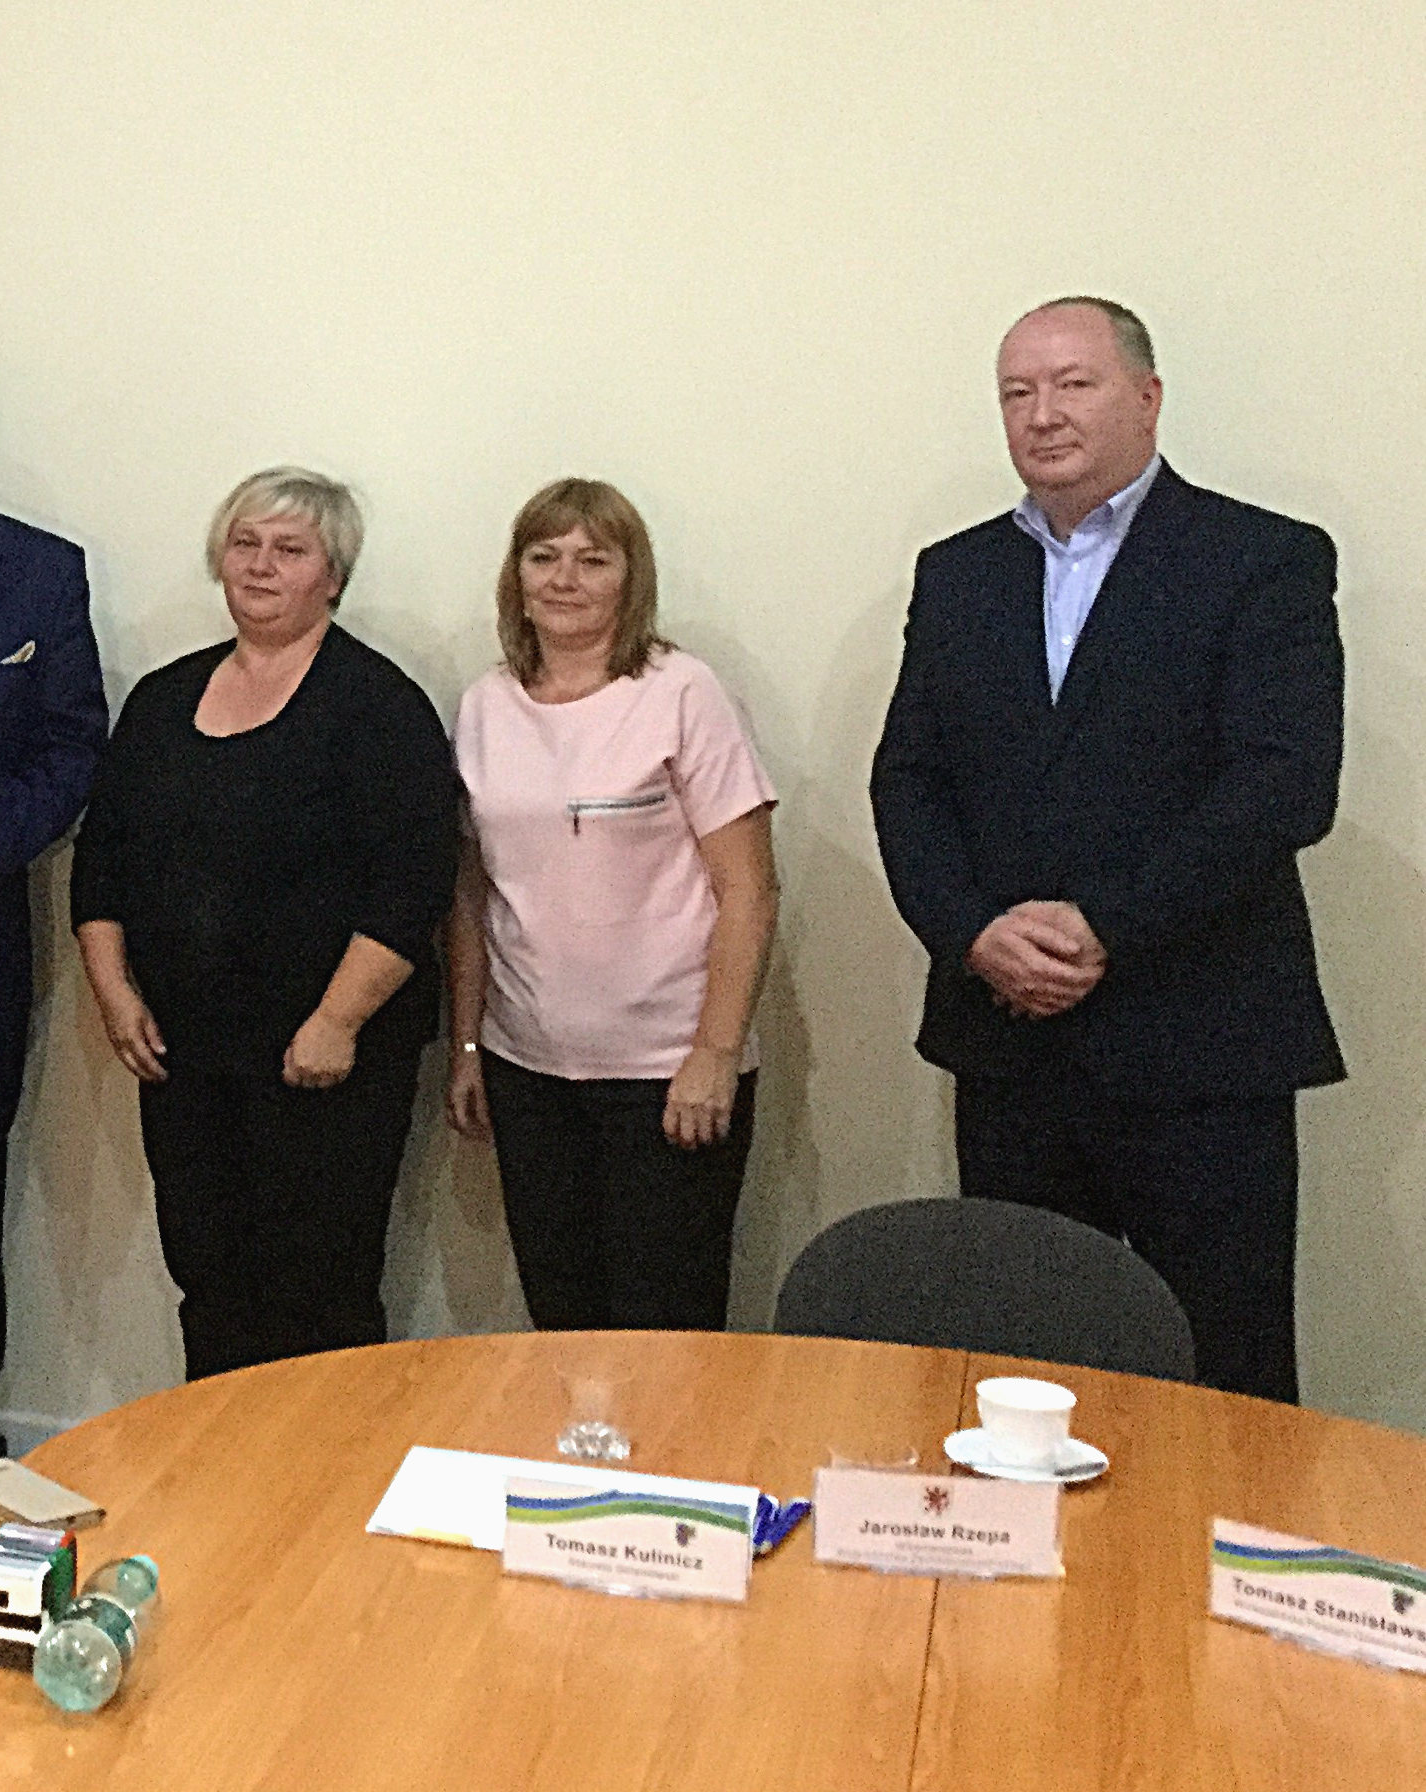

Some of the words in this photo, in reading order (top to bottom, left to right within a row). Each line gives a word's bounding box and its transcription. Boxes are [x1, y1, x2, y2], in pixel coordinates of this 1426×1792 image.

[546, 1532, 618, 1558] Tomasz
[625, 1545, 704, 1570] Kulinicz
[951, 1524, 1011, 1545] Rzepa
[1233, 1575, 1307, 1611] Tomasz
